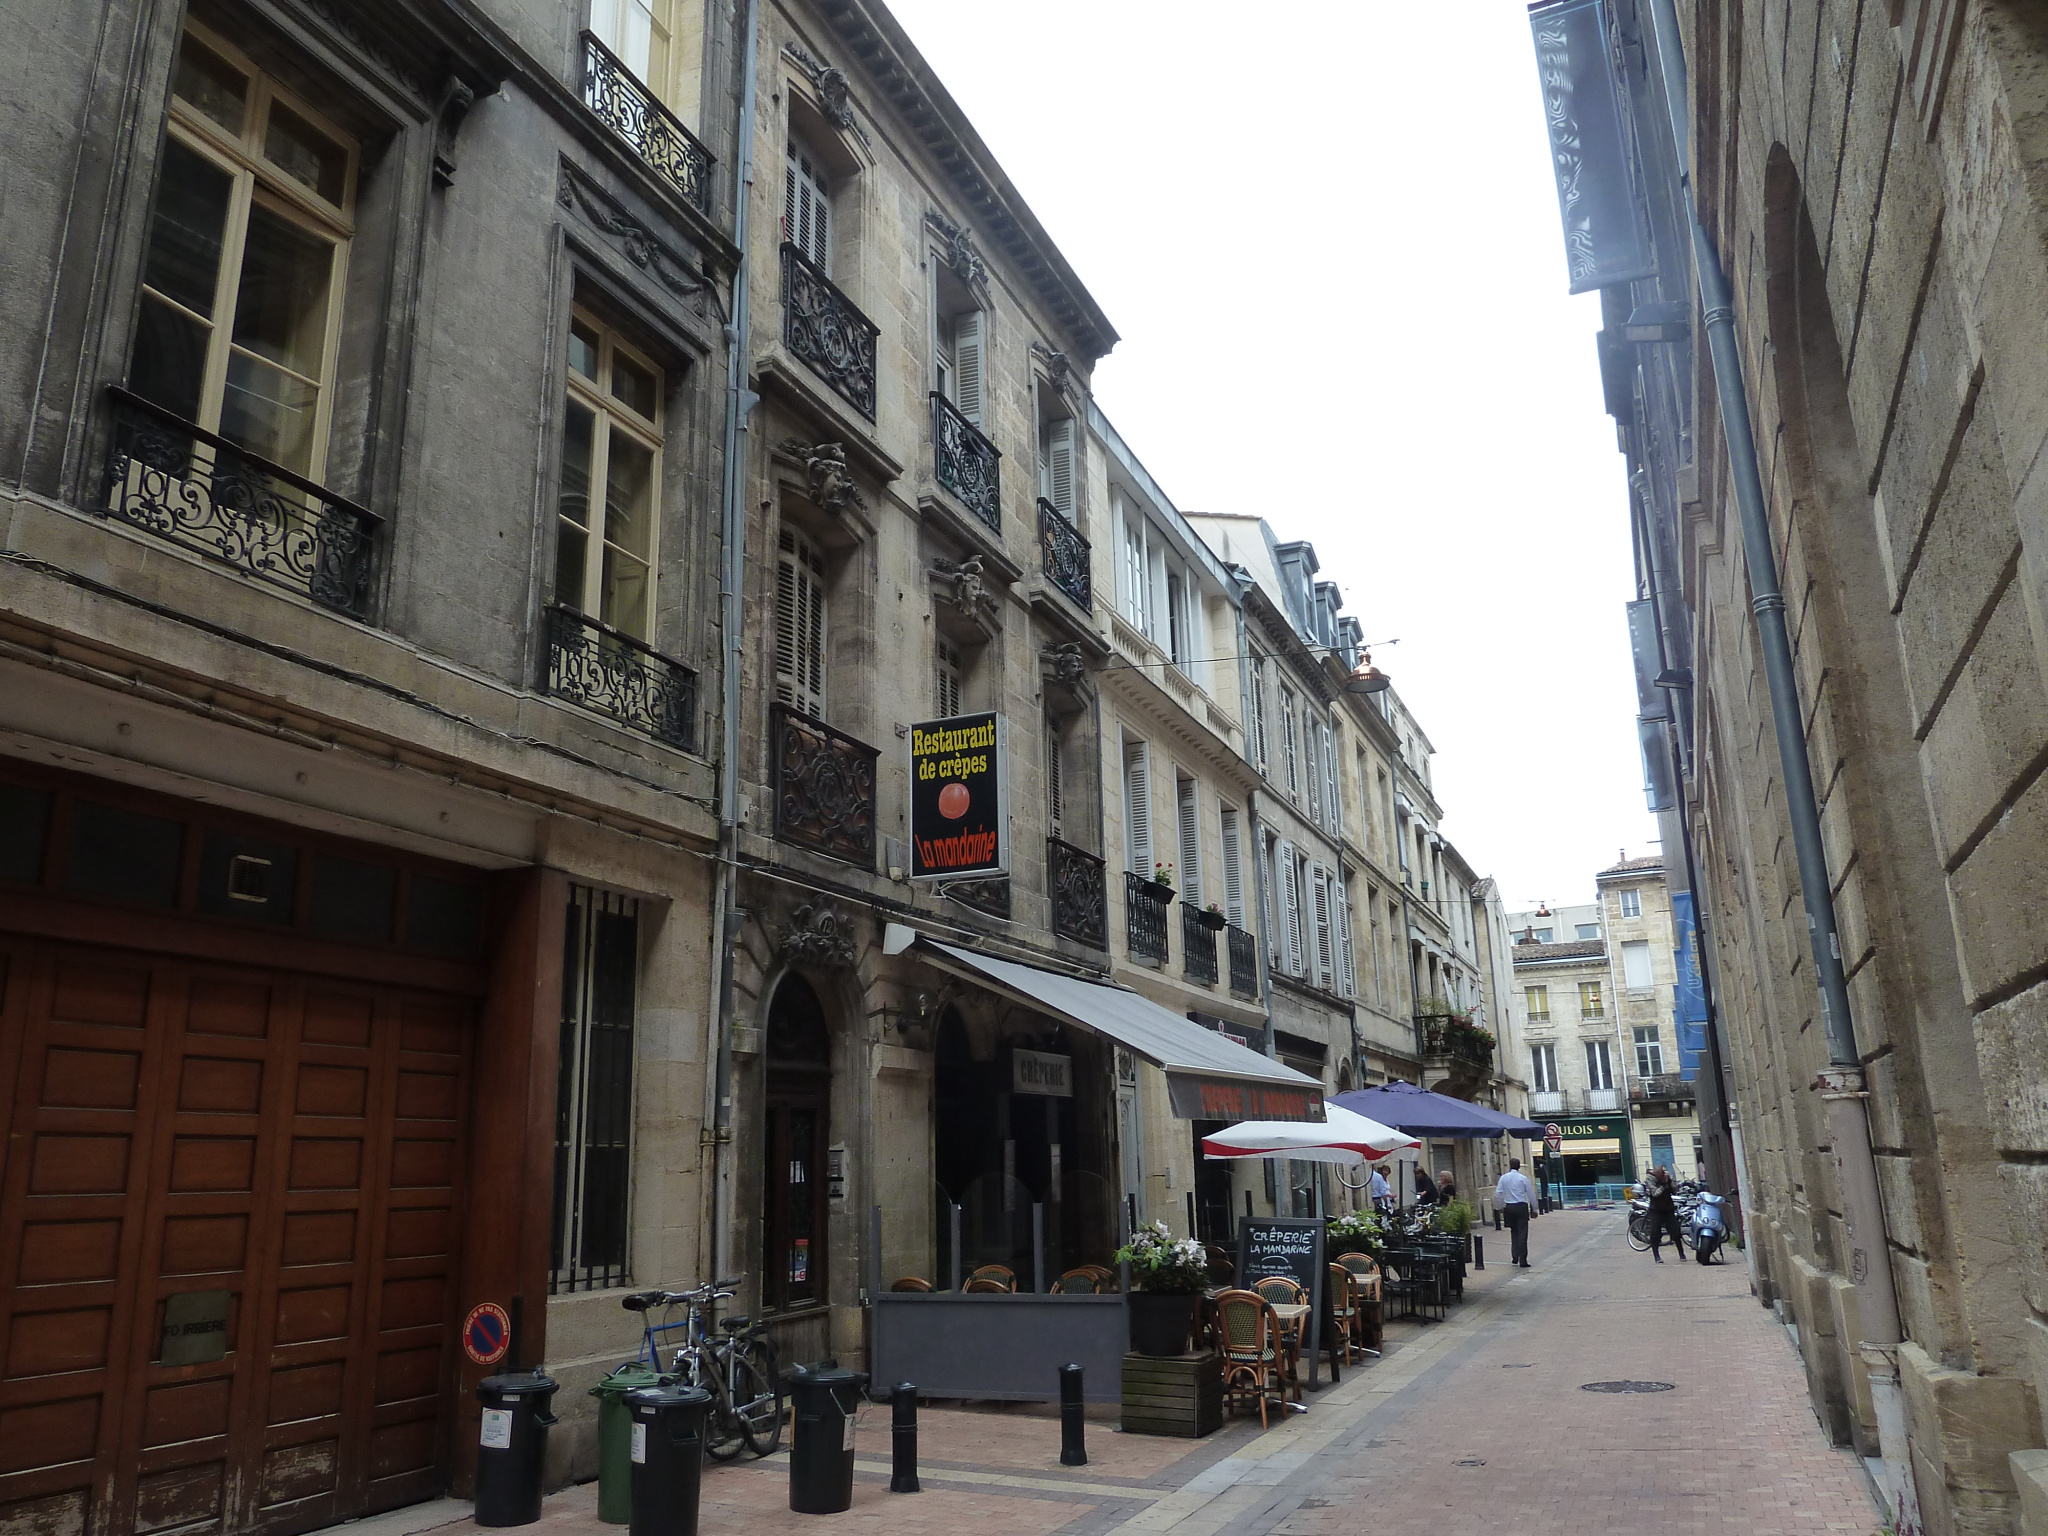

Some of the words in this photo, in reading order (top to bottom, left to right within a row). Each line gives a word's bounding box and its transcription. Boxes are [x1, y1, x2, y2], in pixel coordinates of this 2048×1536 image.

[912, 719, 995, 756] Restaurant
[919, 758, 936, 781] de
[914, 834, 935, 868] La
[934, 824, 996, 867] mandarine
[822, 919, 833, 934] 12
[1021, 1058, 1065, 1087] CRÊPERIE
[1250, 1244, 1261, 1254] LA
